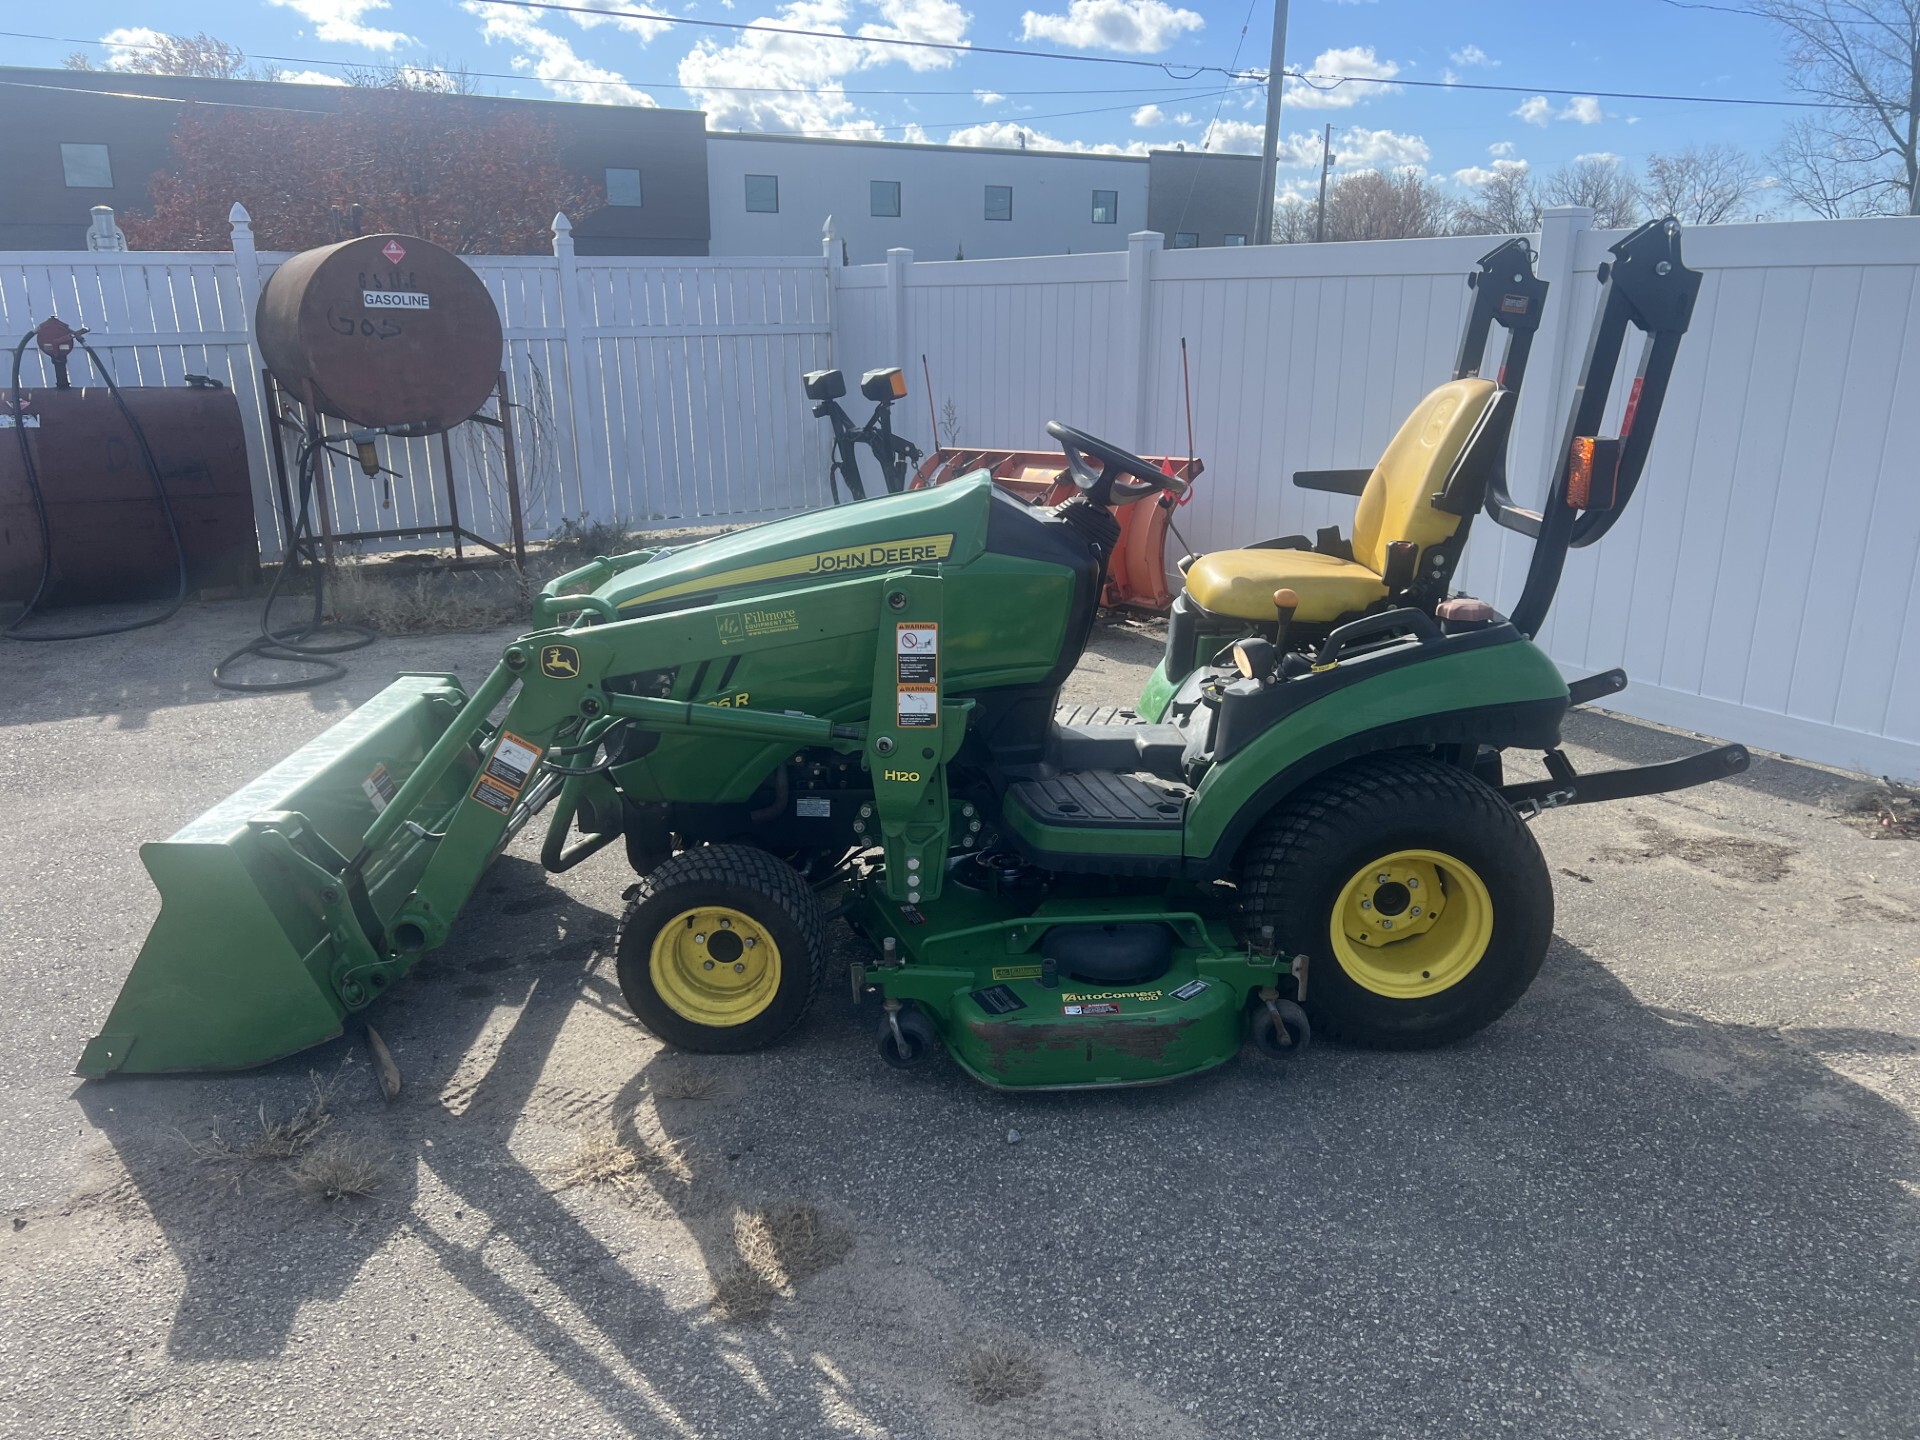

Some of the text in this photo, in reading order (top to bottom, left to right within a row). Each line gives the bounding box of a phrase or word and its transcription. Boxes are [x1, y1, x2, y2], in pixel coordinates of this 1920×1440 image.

[364, 293, 429, 306] GASOLINE
[808, 545, 937, 572] JOHN DEERE
[743, 609, 796, 625] Fillmore
[884, 769, 921, 782] H120
[1064, 989, 1164, 1003] AutoConnect
